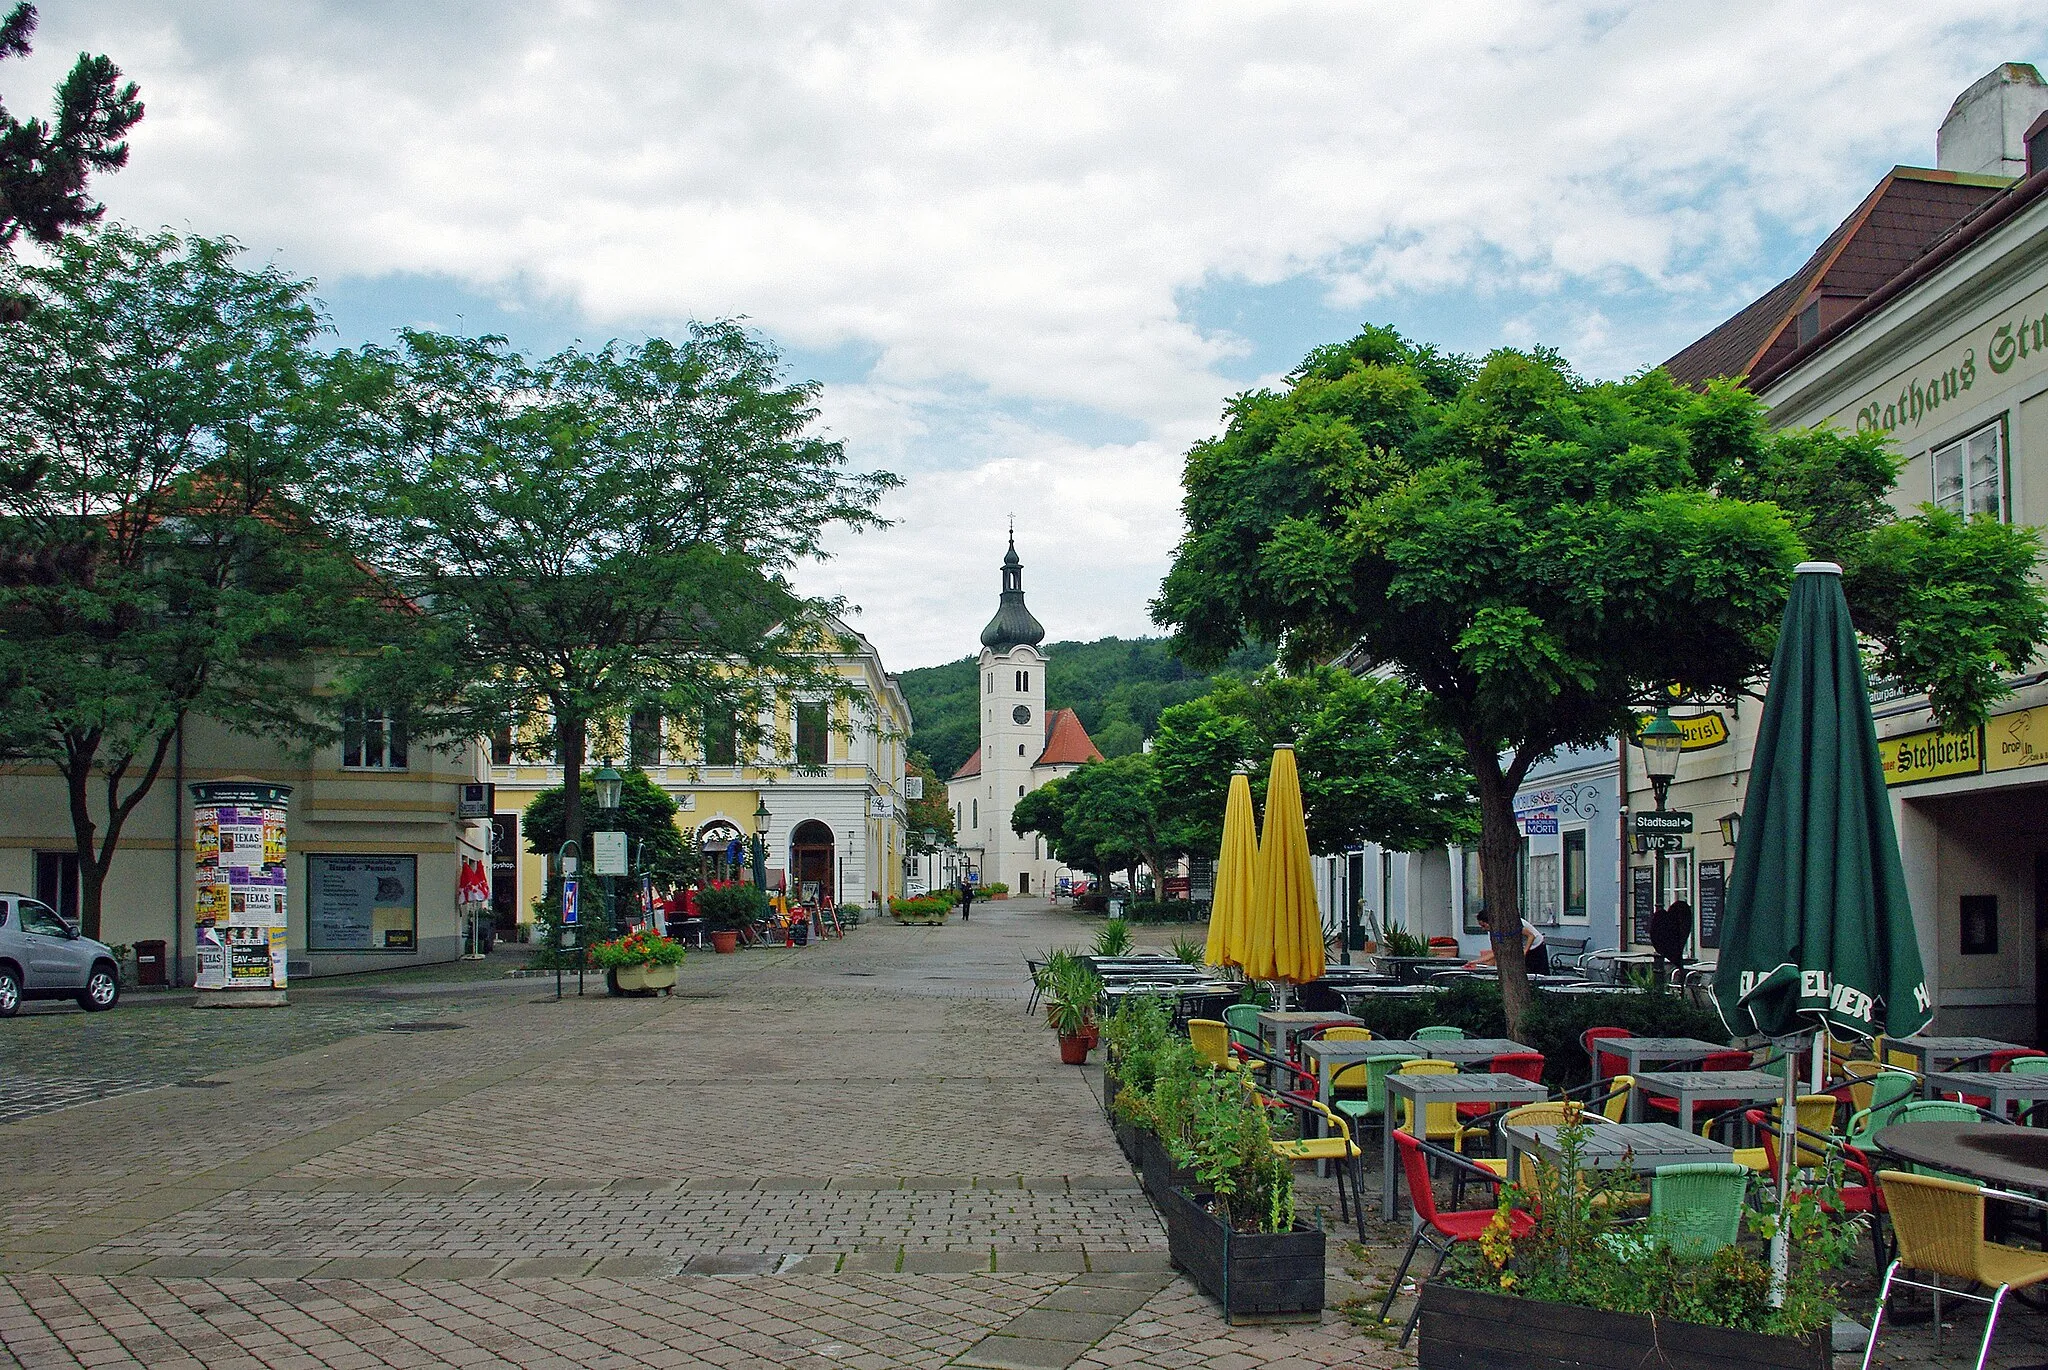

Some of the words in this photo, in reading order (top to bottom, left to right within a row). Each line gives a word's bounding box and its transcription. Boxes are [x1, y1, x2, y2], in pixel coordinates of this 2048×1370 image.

[1857, 347, 1976, 434] Rathaus
[1897, 729, 1977, 773] Stehbeisl
[2002, 741, 2020, 755] Drop
[796, 770, 828, 778] NOTAR
[1637, 816, 1680, 828] Stadtsaal
[234, 832, 262, 842] TEXAS-
[1646, 837, 1665, 848] WC
[365, 864, 397, 872] Pension
[493, 861, 515, 870] pyshop.
[245, 893, 271, 903] TEXAS-
